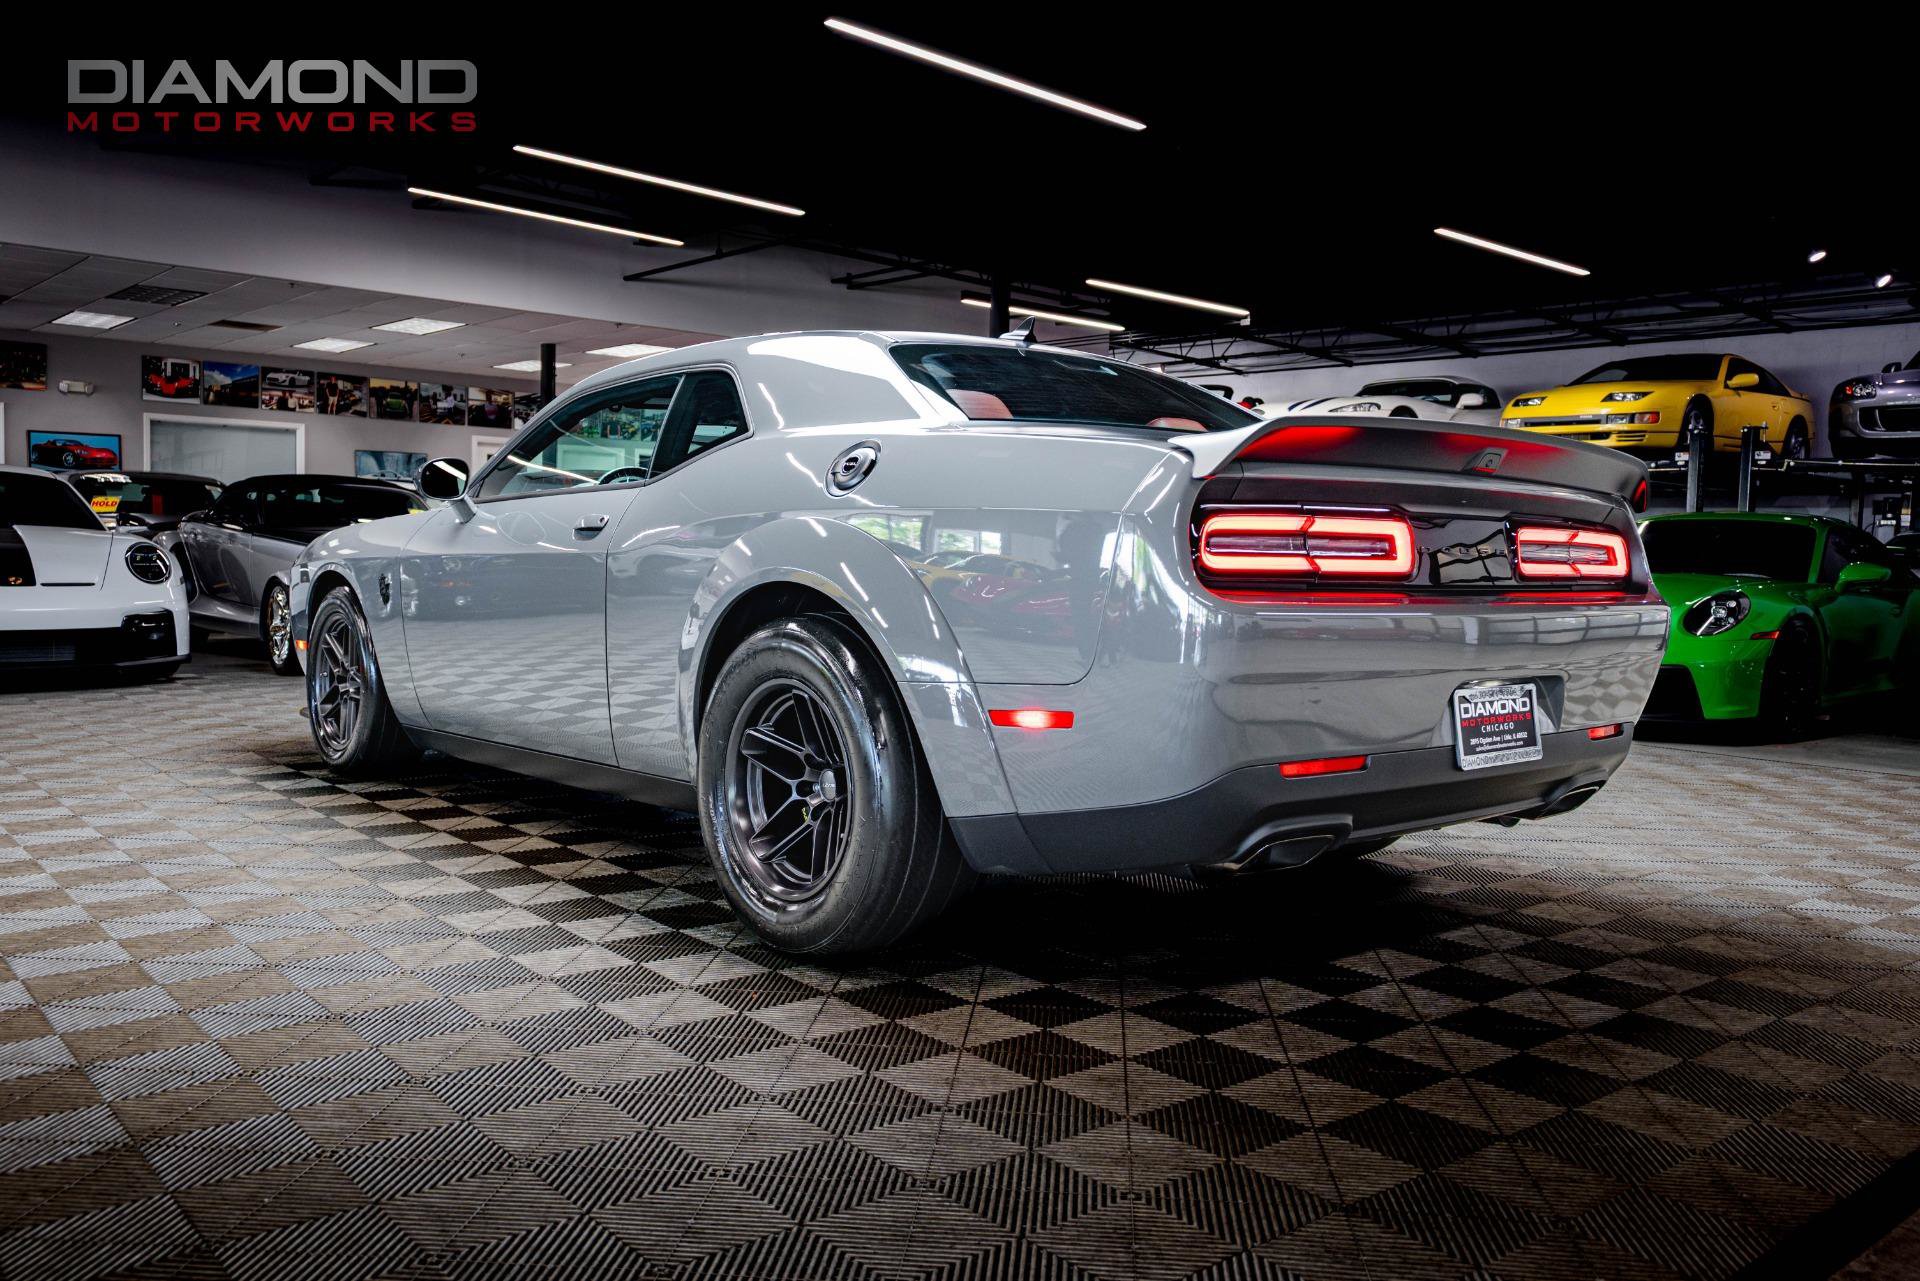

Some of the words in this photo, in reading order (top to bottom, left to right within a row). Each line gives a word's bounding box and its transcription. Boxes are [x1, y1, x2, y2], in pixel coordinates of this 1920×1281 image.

[1460, 697, 1530, 718] DIAMOND
[1461, 712, 1532, 727] MOTORWORKS
[1481, 721, 1515, 732] CHICAGO
